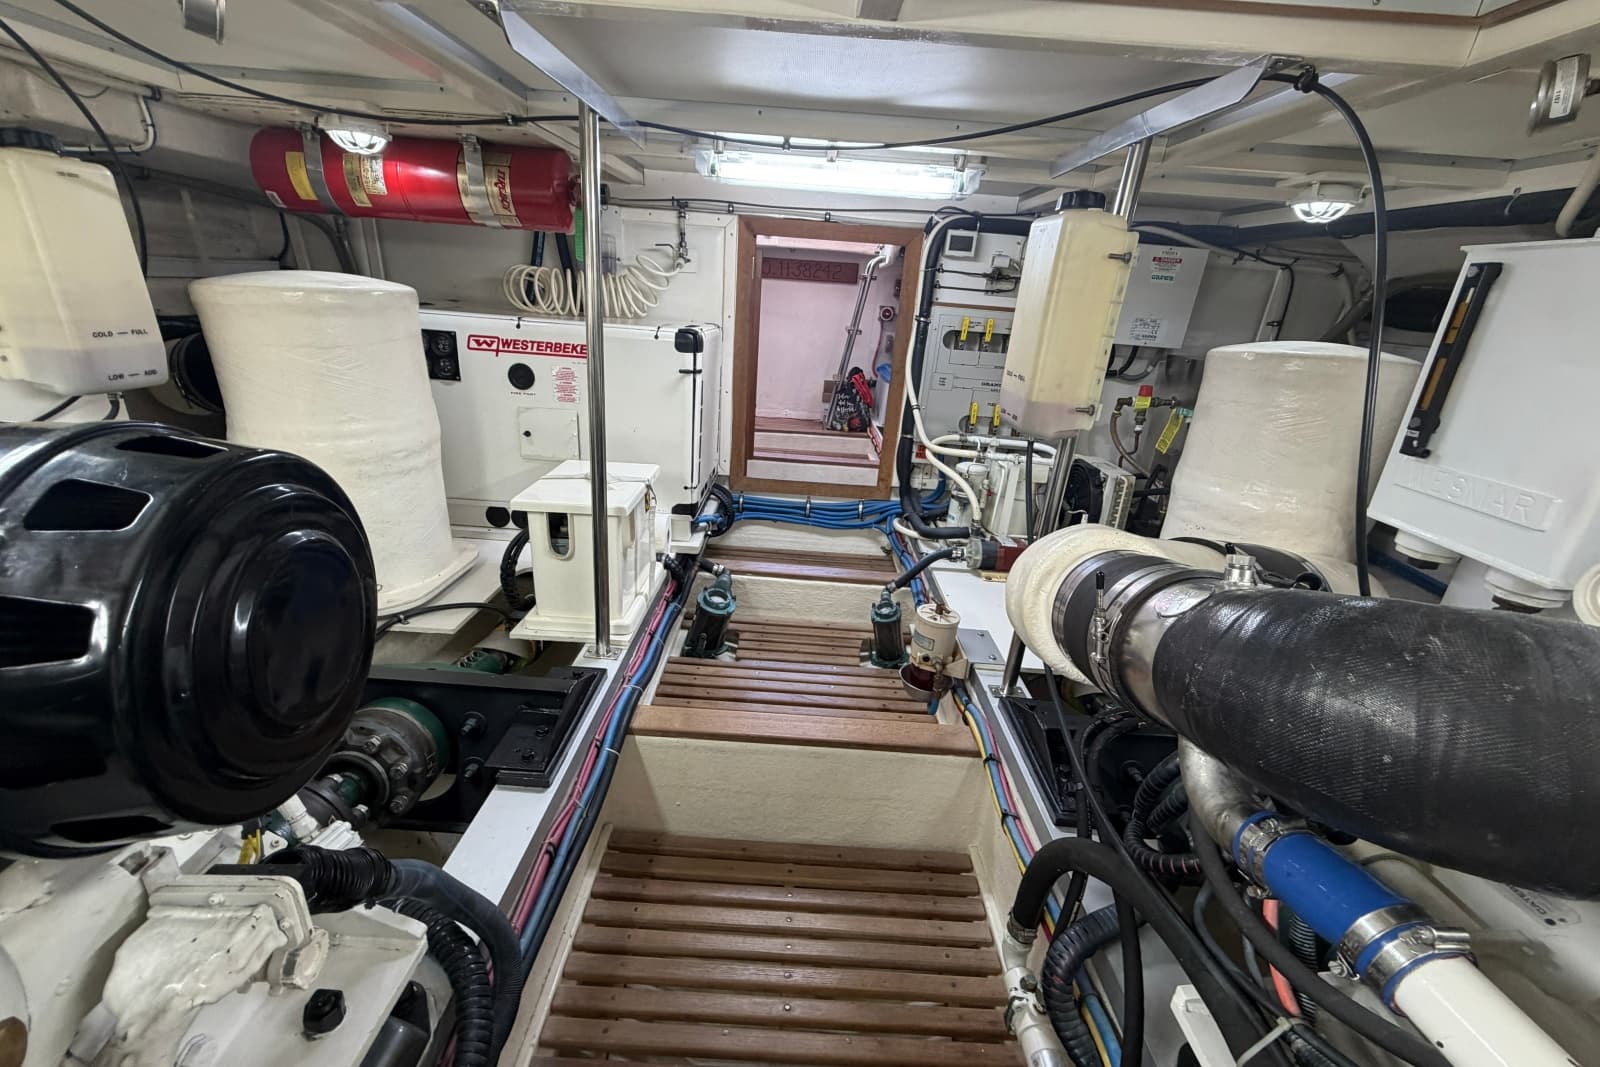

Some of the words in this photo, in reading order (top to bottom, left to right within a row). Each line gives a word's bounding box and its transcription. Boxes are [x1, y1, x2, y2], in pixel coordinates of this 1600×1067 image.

[92, 331, 114, 339] COLD
[130, 328, 149, 336] FULL
[500, 338, 588, 355] WESTERBEKE
[108, 373, 125, 381] LOW
